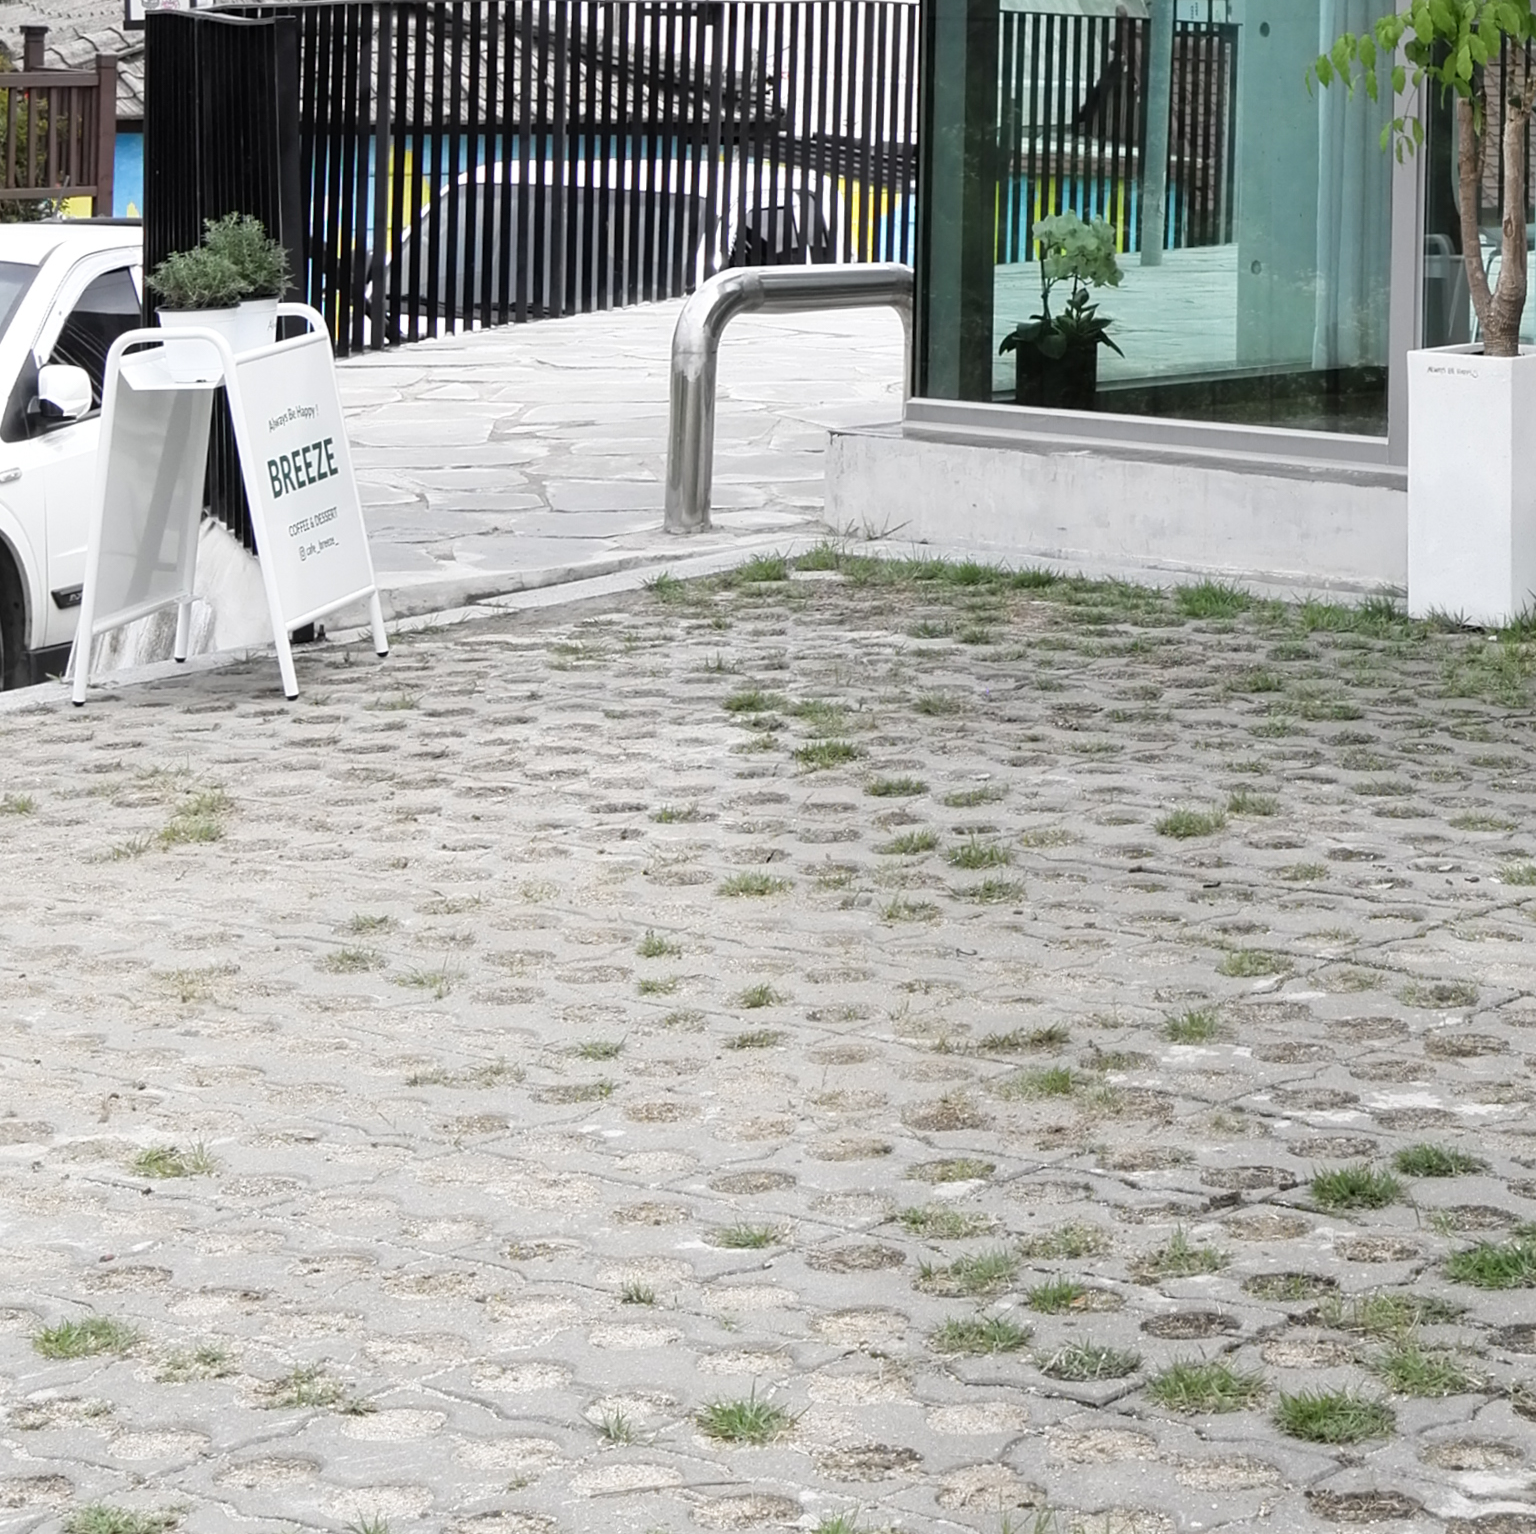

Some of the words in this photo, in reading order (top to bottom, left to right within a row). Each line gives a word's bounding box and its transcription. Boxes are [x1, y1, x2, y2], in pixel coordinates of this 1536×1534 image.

[268, 415, 289, 433] Always
[296, 405, 316, 419] Happy
[267, 437, 339, 499] BREEZE
[288, 517, 310, 537] COFFEE
[314, 506, 338, 525] DESSERT
